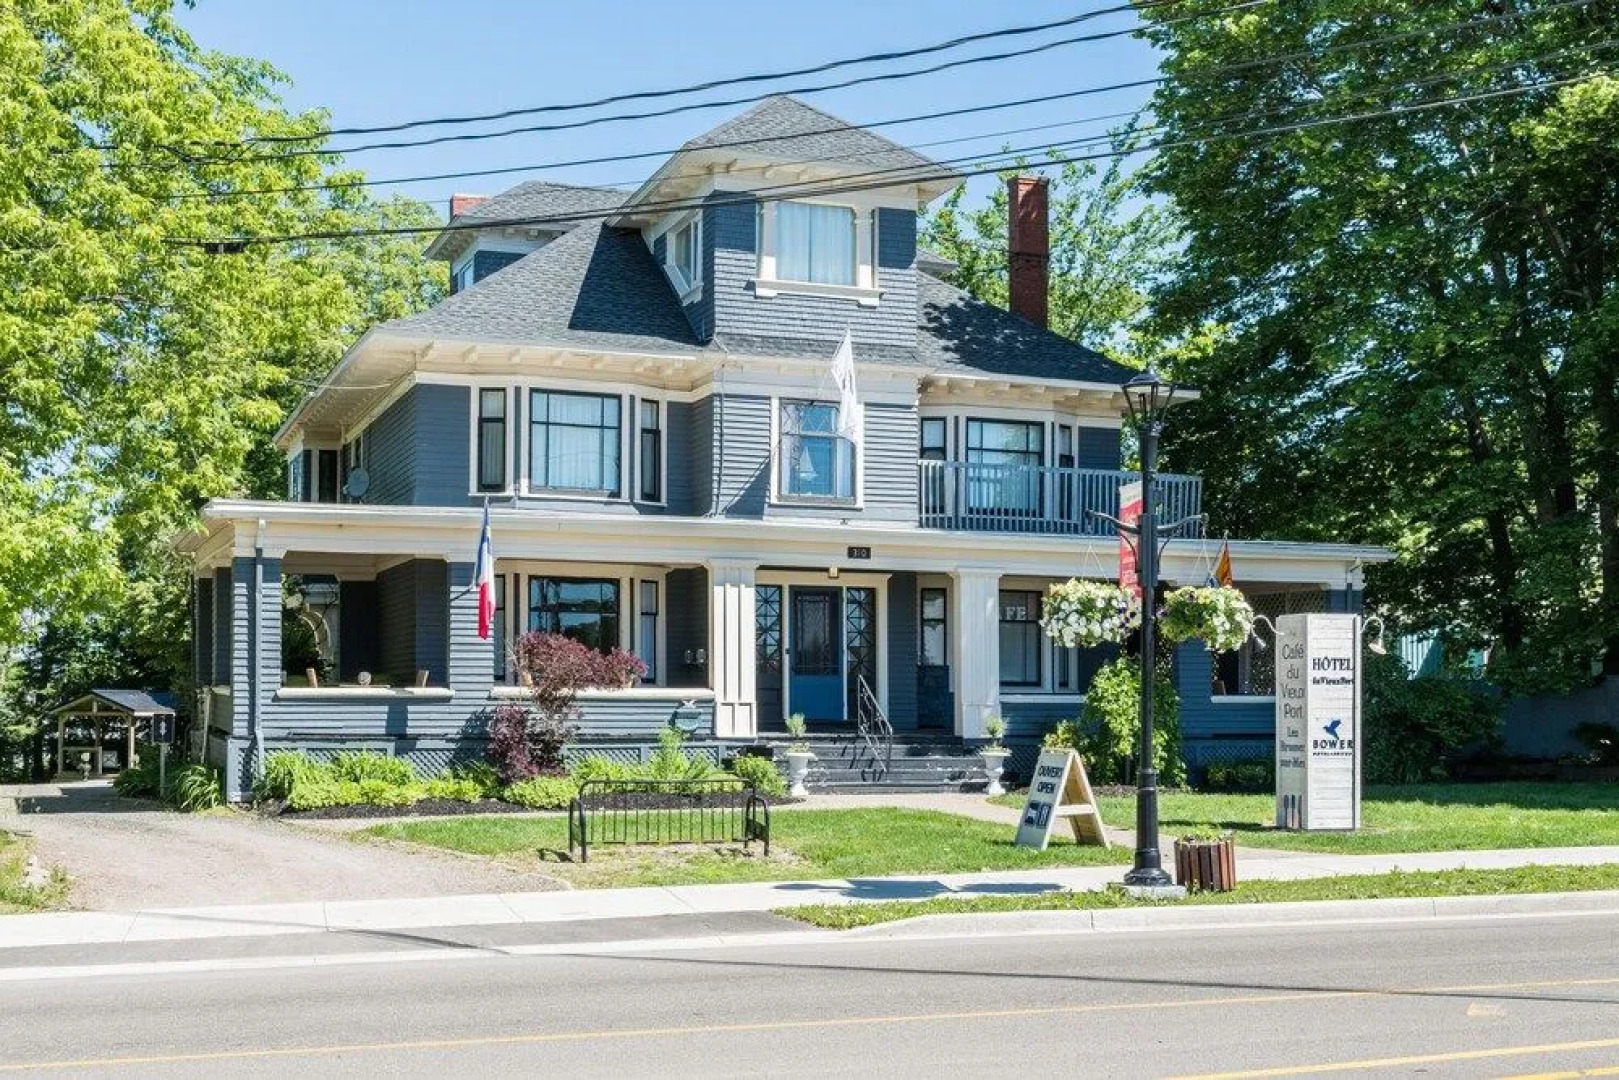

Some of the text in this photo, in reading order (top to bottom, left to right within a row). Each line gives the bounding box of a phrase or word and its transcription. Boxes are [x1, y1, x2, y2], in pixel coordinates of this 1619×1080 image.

[999, 606, 1026, 621] FE
[1281, 643, 1304, 660] Café
[1312, 656, 1355, 671] HÔTEL
[1286, 664, 1299, 679] du
[1283, 703, 1303, 719] Port
[1312, 739, 1355, 749] BOWER
[1037, 781, 1056, 794] OPEN
